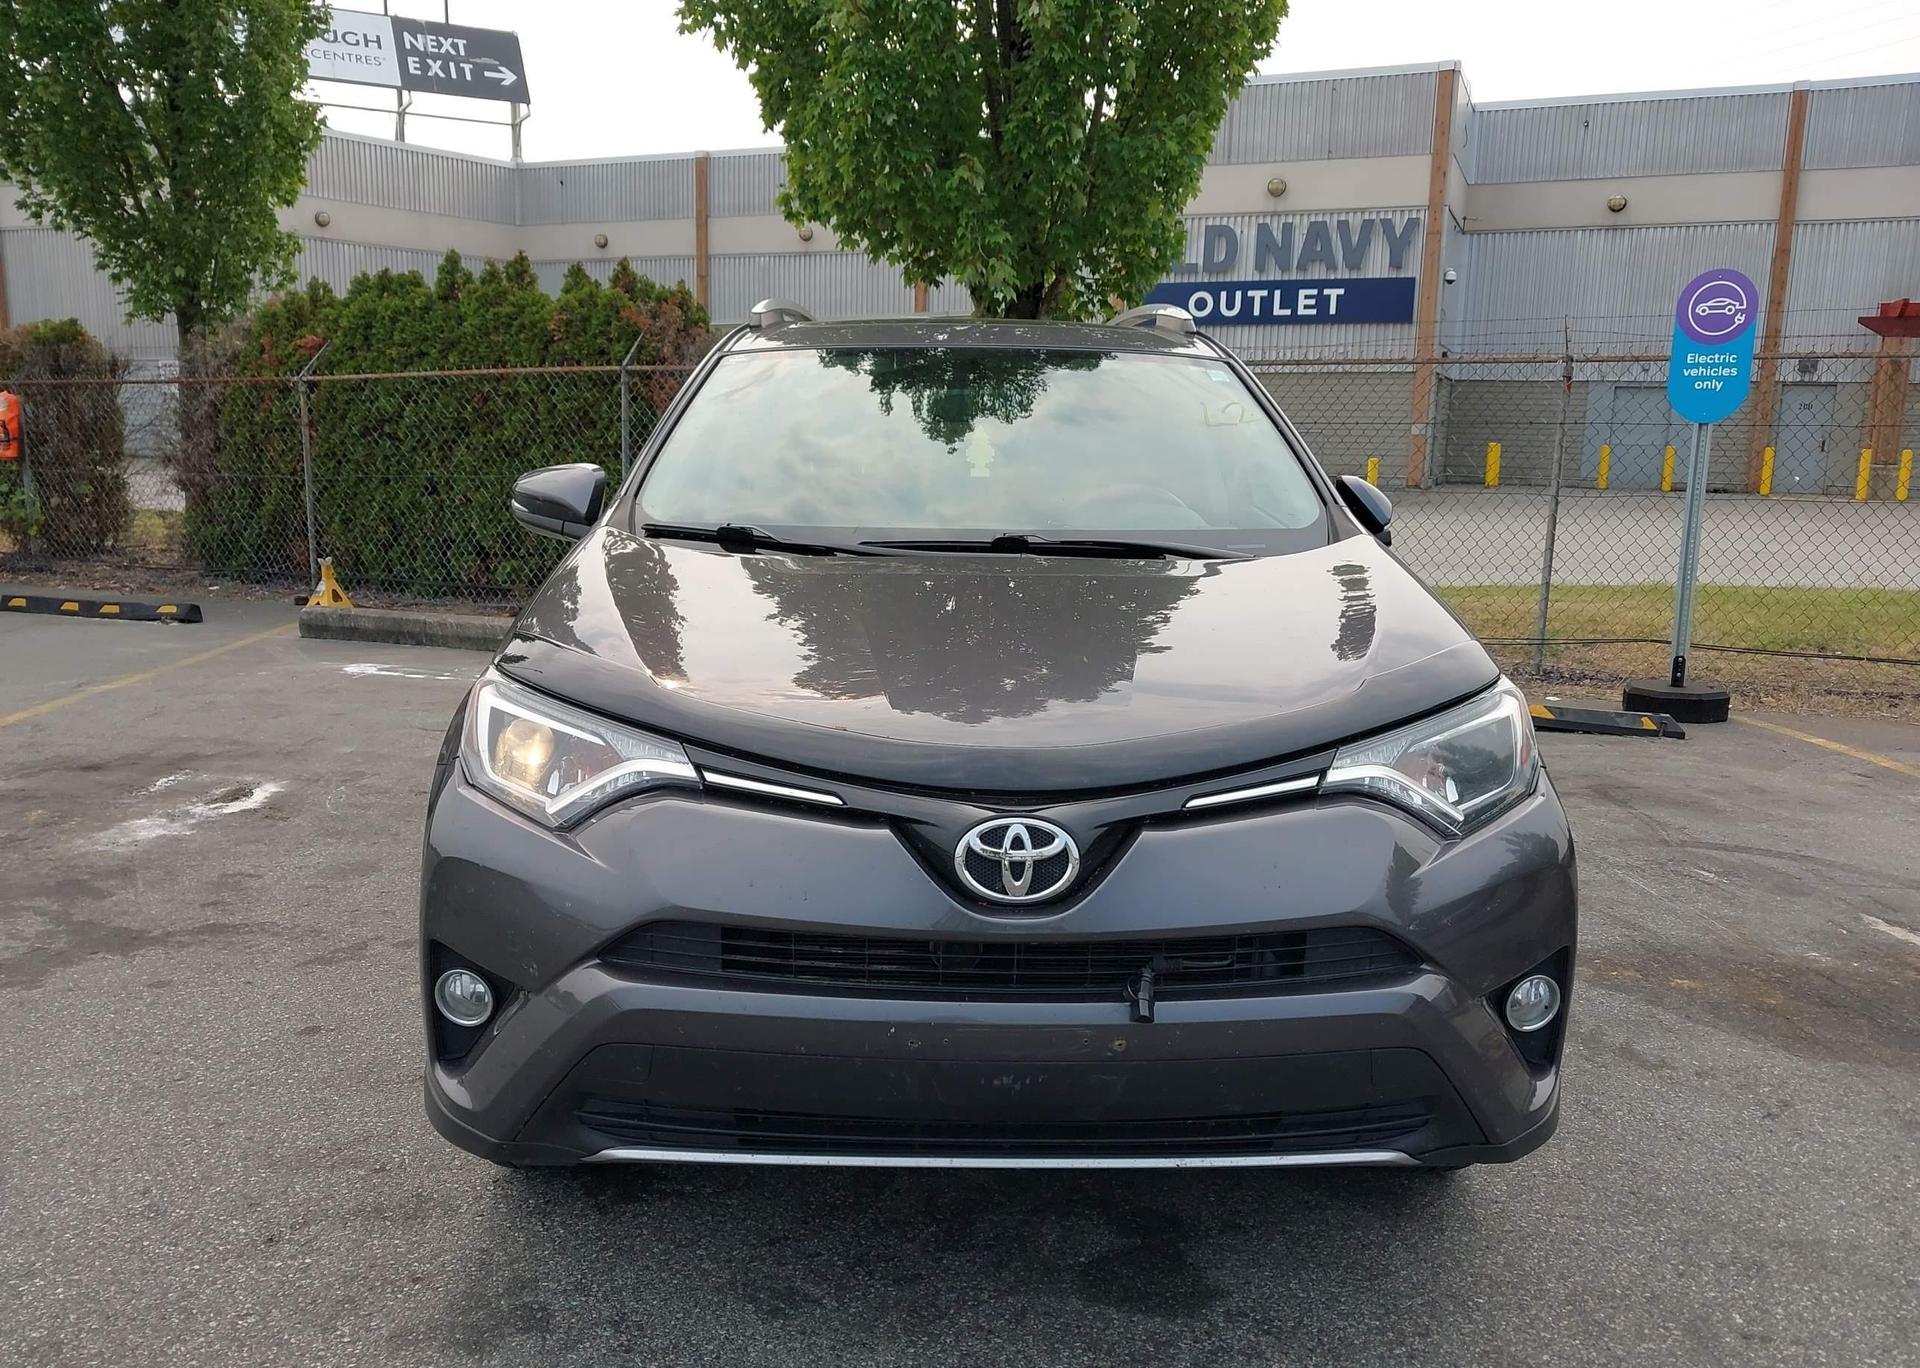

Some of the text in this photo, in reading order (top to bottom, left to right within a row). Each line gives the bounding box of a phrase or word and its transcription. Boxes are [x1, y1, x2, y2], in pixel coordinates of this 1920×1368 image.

[403, 31, 467, 56] NEXT
[407, 56, 473, 81] EXIT
[1255, 217, 1420, 272] NAVY
[1188, 288, 1345, 318] OUTLET
[1687, 352, 1738, 364] Electric
[1683, 365, 1738, 377] vehicles
[1694, 379, 1724, 392] only
